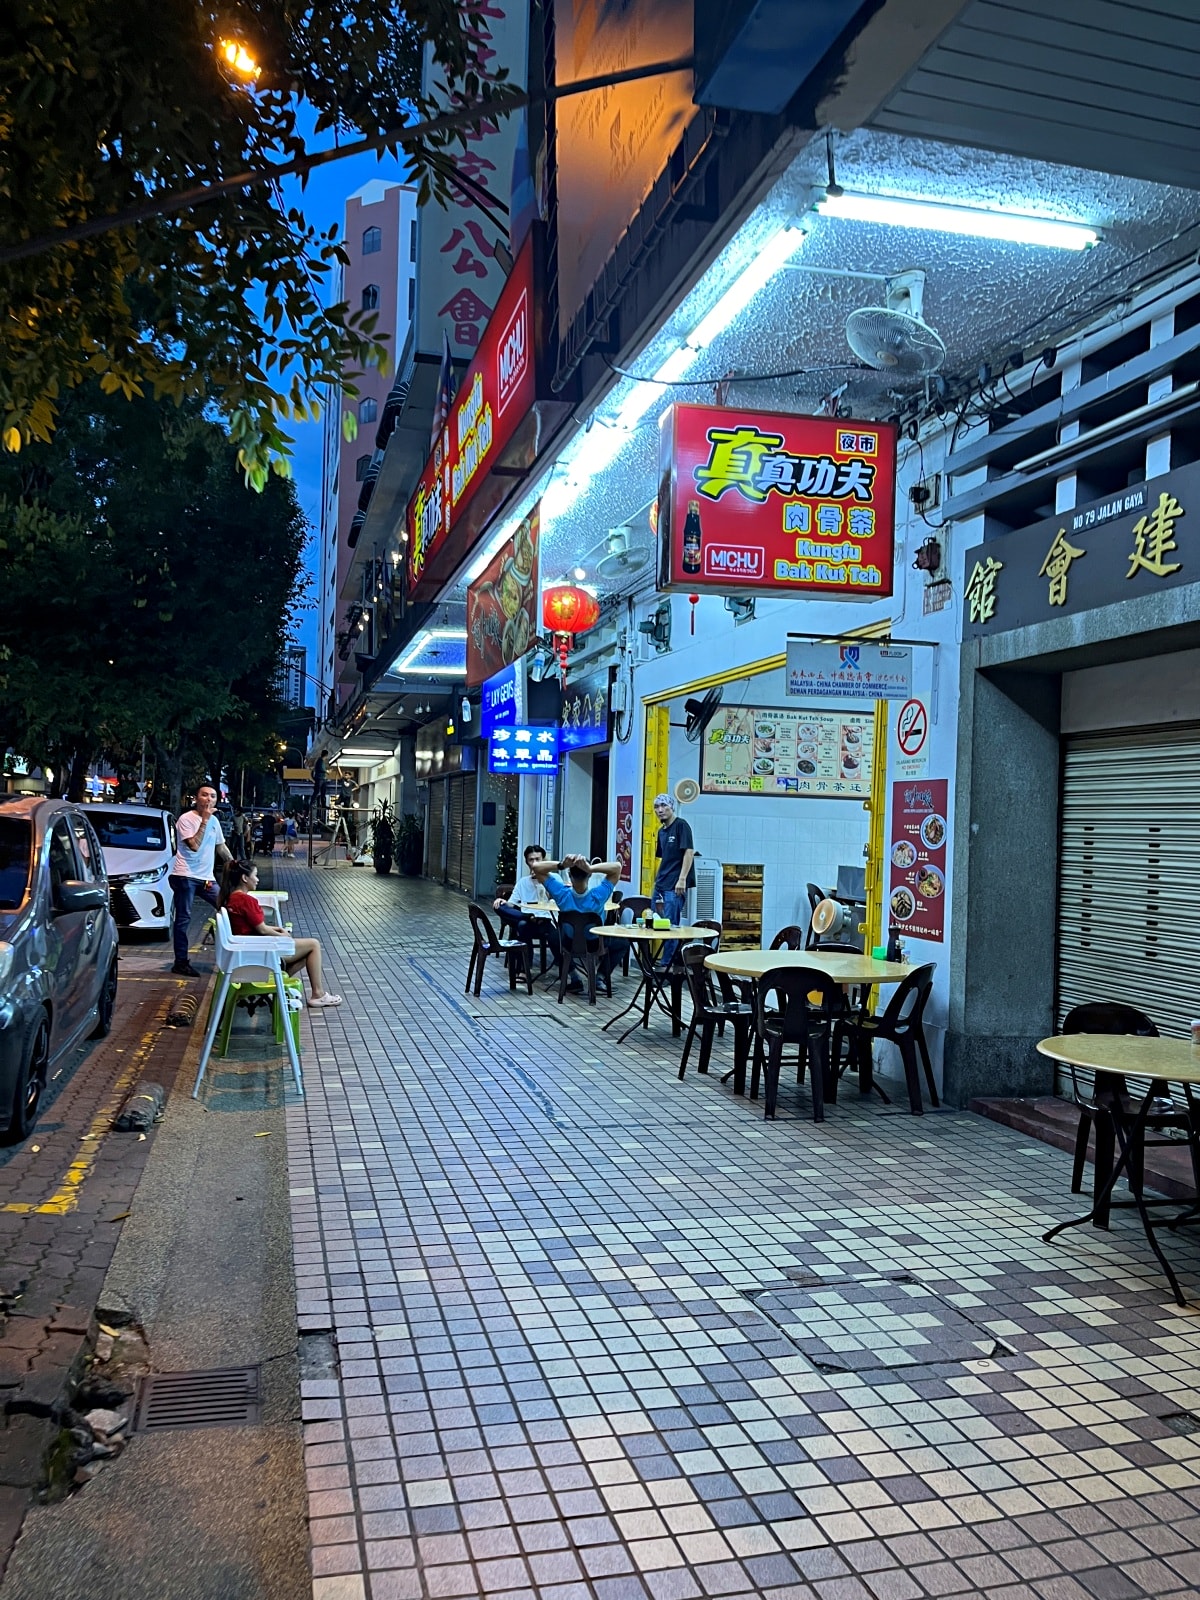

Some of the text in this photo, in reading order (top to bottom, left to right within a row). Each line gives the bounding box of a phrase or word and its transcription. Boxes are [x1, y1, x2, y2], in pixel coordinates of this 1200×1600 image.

[500, 311, 526, 391] MICHU
[840, 433, 875, 452] 夜市
[785, 503, 875, 536] 肉骨茶
[1073, 491, 1143, 530] NO 79 JALAN GAYA
[711, 549, 759, 569] MICHU
[797, 540, 860, 562] Kungfu
[776, 561, 812, 580] Bak
[816, 564, 846, 582] Kut
[850, 566, 880, 584] Teh
[790, 687, 807, 695] DEWAN
[807, 688, 841, 696] PERDAGANGAN
[842, 689, 865, 697] MALAYSIA
[869, 690, 883, 698] CHINA
[832, 681, 854, 689] CHAMBER
[862, 682, 887, 690] COMMERCE
